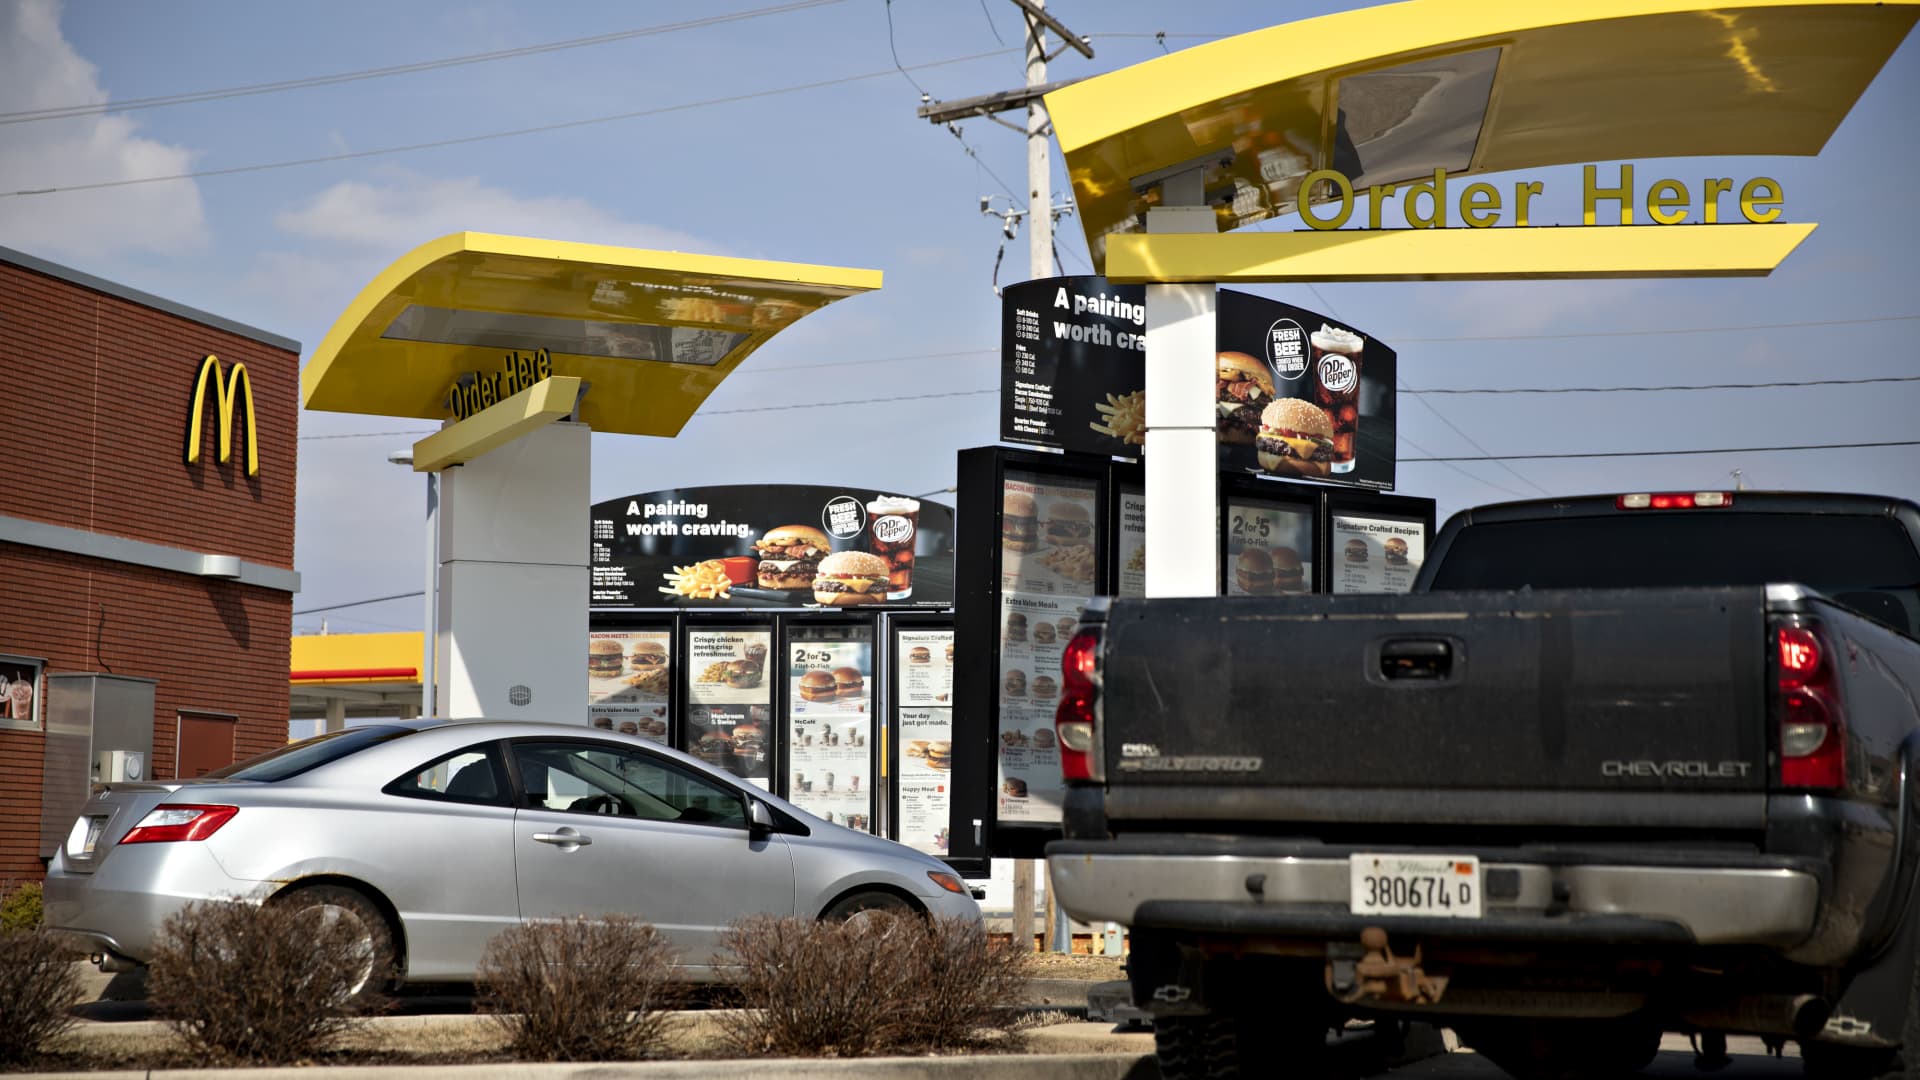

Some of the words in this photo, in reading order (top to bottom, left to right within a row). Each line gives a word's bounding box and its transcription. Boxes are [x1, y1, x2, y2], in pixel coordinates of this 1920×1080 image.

[1297, 168, 1544, 230] Order
[1583, 164, 1785, 225] Here
[1053, 287, 1070, 309] A
[1074, 292, 1145, 325] pairing
[1053, 321, 1112, 346] worth
[1272, 330, 1300, 342] FRESH
[1274, 341, 1302, 356] BEEF
[1324, 361, 1352, 385] Pepper
[1332, 360, 1344, 372] Dr
[449, 371, 502, 423] Order
[503, 347, 552, 397] Here
[626, 501, 640, 516] A
[644, 500, 708, 518] pairing
[828, 502, 856, 514] FRESH
[626, 520, 678, 536] worth
[682, 520, 754, 538] craving.
[880, 522, 908, 538] Pepper
[888, 519, 900, 529] Dr
[1232, 515, 1244, 535] 2
[1244, 522, 1257, 533] for
[1336, 522, 1368, 533] Signature
[1368, 524, 1392, 534] Crafted
[1394, 527, 1420, 536] Recipes
[795, 649, 806, 662] 2
[1601, 760, 1752, 778] CHEVROLET
[1364, 876, 1451, 908] 380674
[1459, 882, 1471, 905] D
